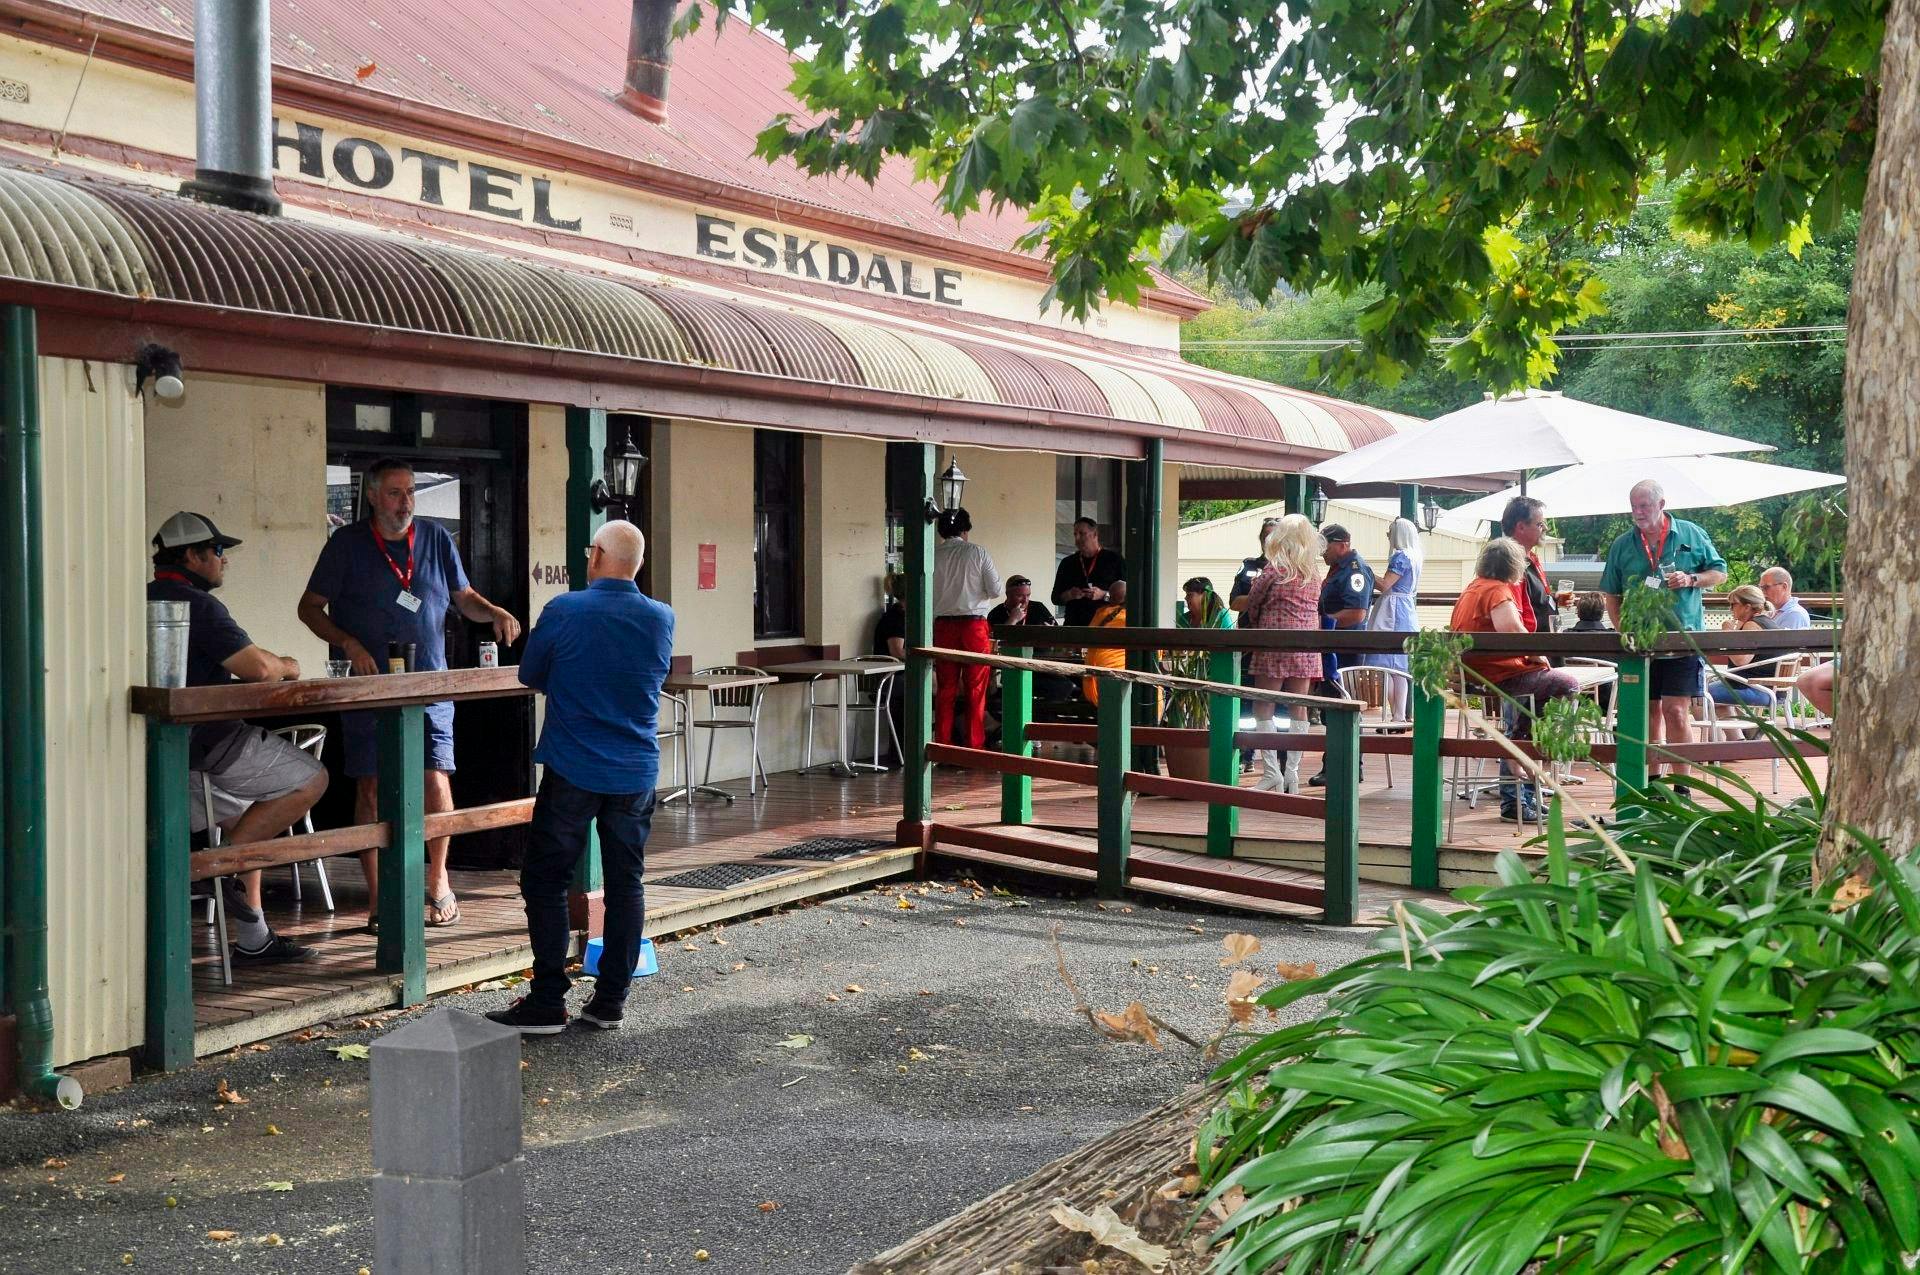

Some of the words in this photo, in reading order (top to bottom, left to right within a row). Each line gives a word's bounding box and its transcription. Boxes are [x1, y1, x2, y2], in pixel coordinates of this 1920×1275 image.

[272, 117, 582, 232] HOTEL
[695, 213, 963, 307] ESKDALE
[545, 565, 570, 585] BAR
